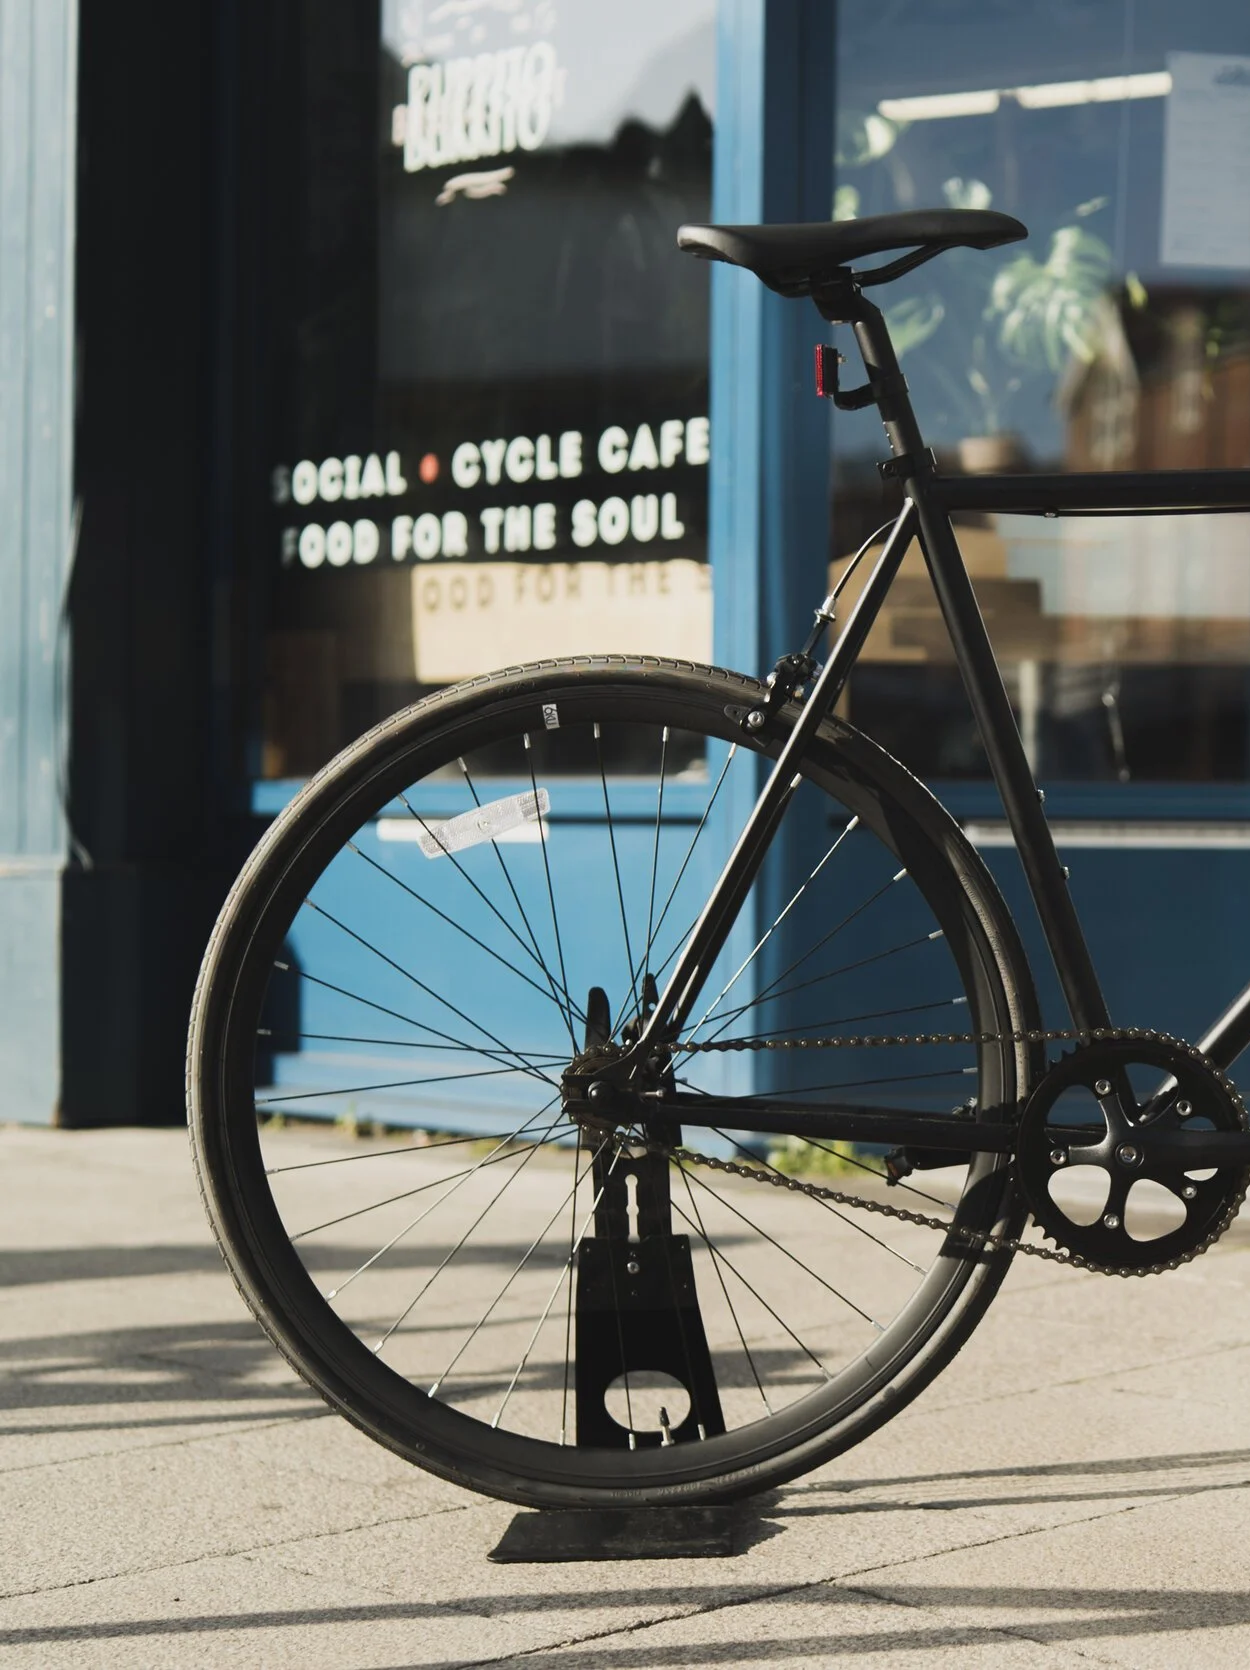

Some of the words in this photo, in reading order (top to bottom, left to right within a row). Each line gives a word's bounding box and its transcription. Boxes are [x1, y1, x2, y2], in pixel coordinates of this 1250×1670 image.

[452, 431, 583, 489] CYCLE
[598, 416, 710, 474] CAFE
[391, 510, 468, 562] FOR
[480, 503, 556, 554] THE
[571, 492, 685, 548] SOUL
[422, 574, 496, 613] OOD
